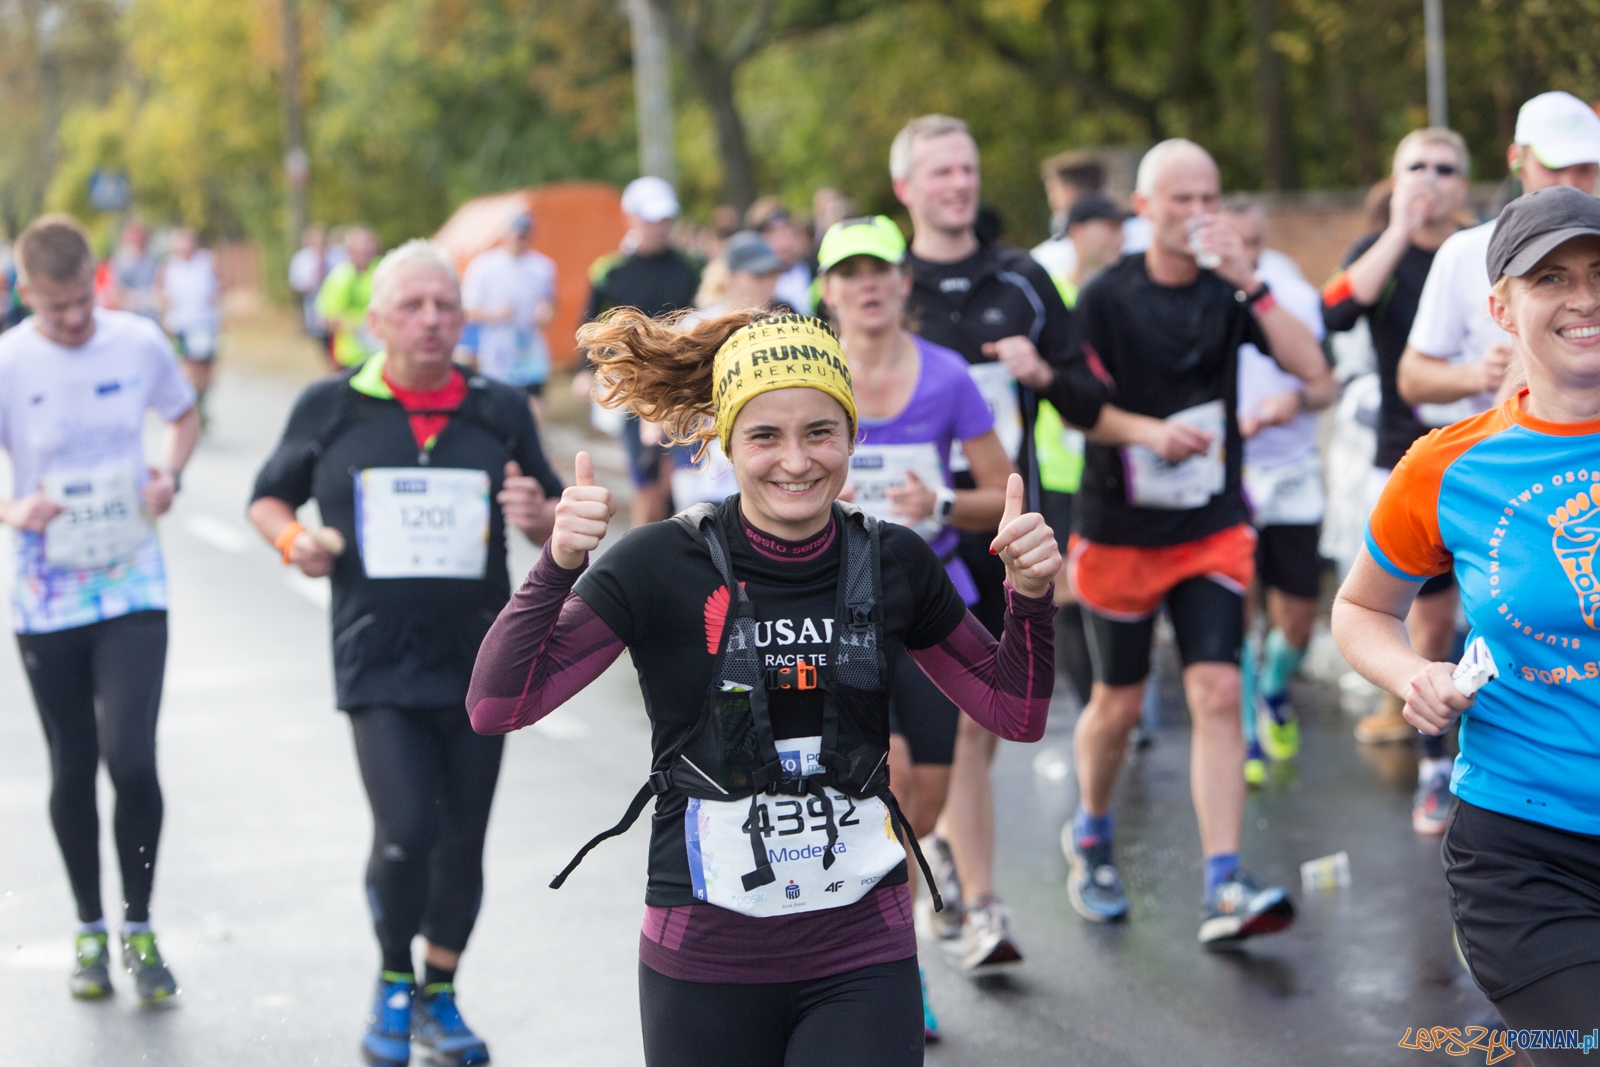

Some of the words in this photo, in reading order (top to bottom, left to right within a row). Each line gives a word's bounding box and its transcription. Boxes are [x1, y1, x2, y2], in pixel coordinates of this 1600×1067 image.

[754, 363, 836, 381] REKRUT
[400, 504, 457, 530] 1201
[745, 528, 787, 554] sesto
[792, 533, 828, 555] senso
[1489, 483, 1544, 598] TOWARZYSTWO
[765, 654, 804, 667] RACE
[742, 794, 860, 838] 4392
[824, 880, 845, 893] 4F
